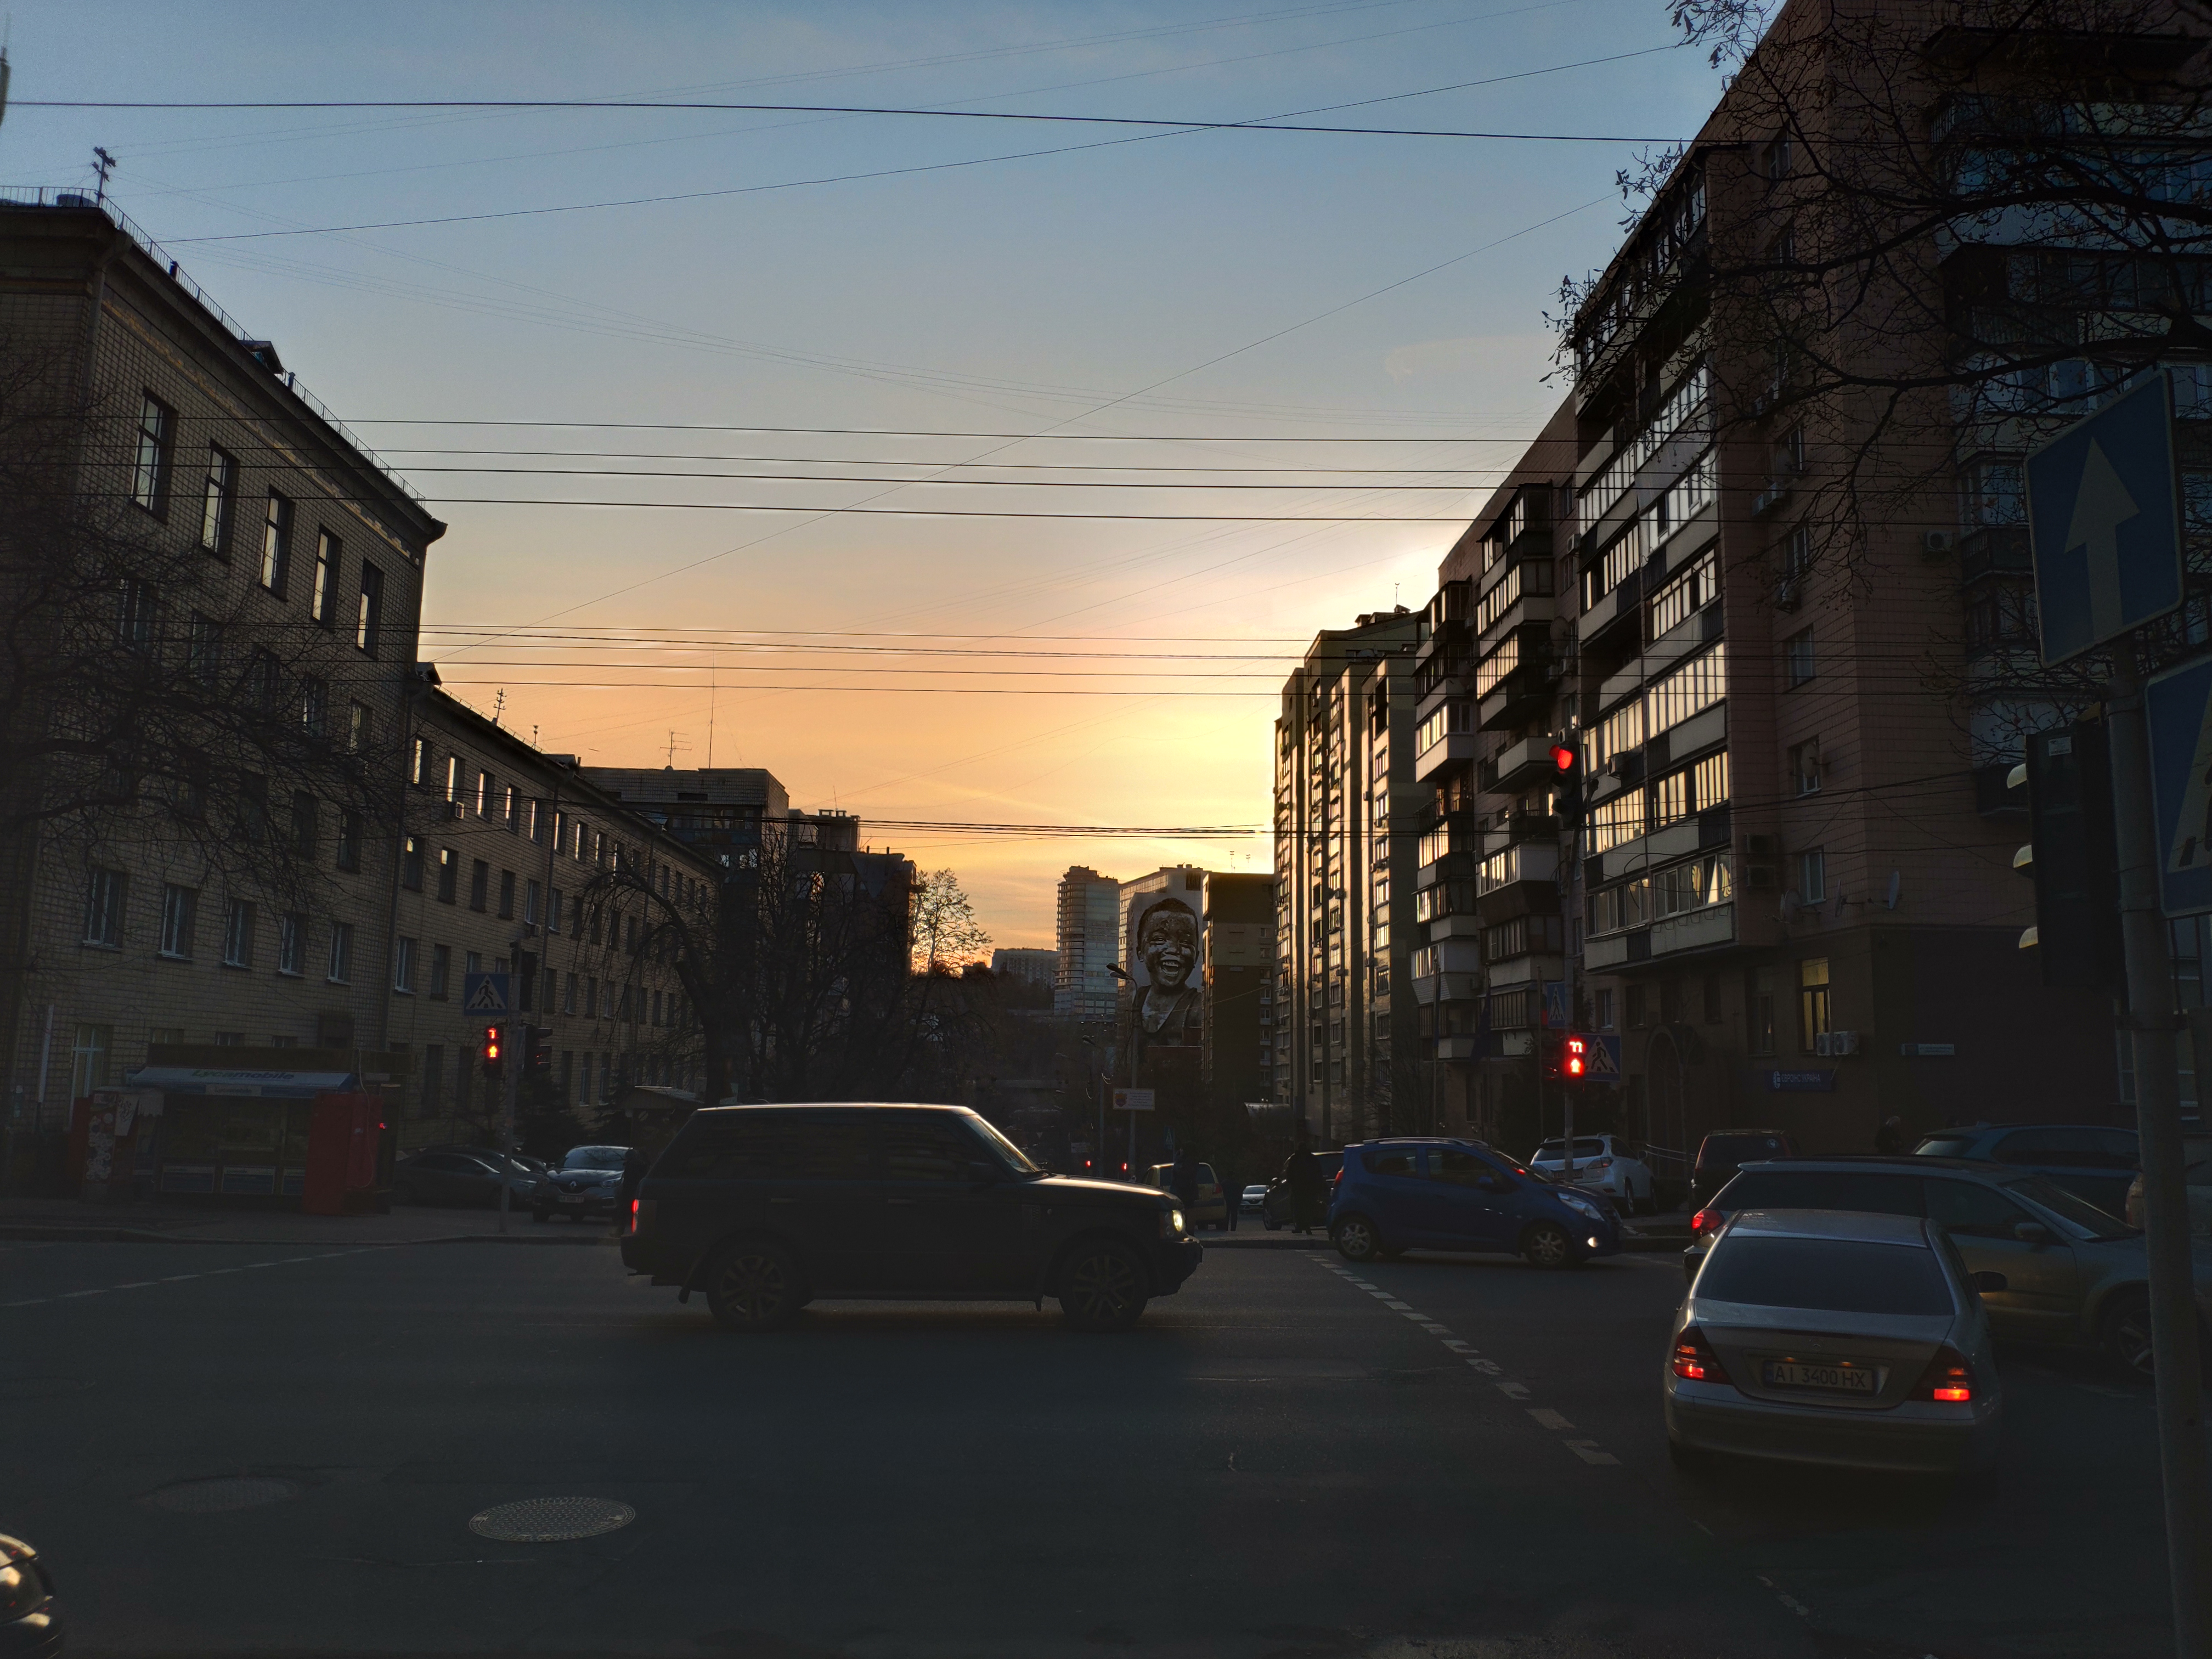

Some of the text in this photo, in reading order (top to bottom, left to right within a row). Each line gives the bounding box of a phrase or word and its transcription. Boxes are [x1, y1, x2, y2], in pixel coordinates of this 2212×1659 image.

[192, 1069, 295, 1080] Lycamobile
[1775, 1366, 1866, 1388] AI 3400 HX
